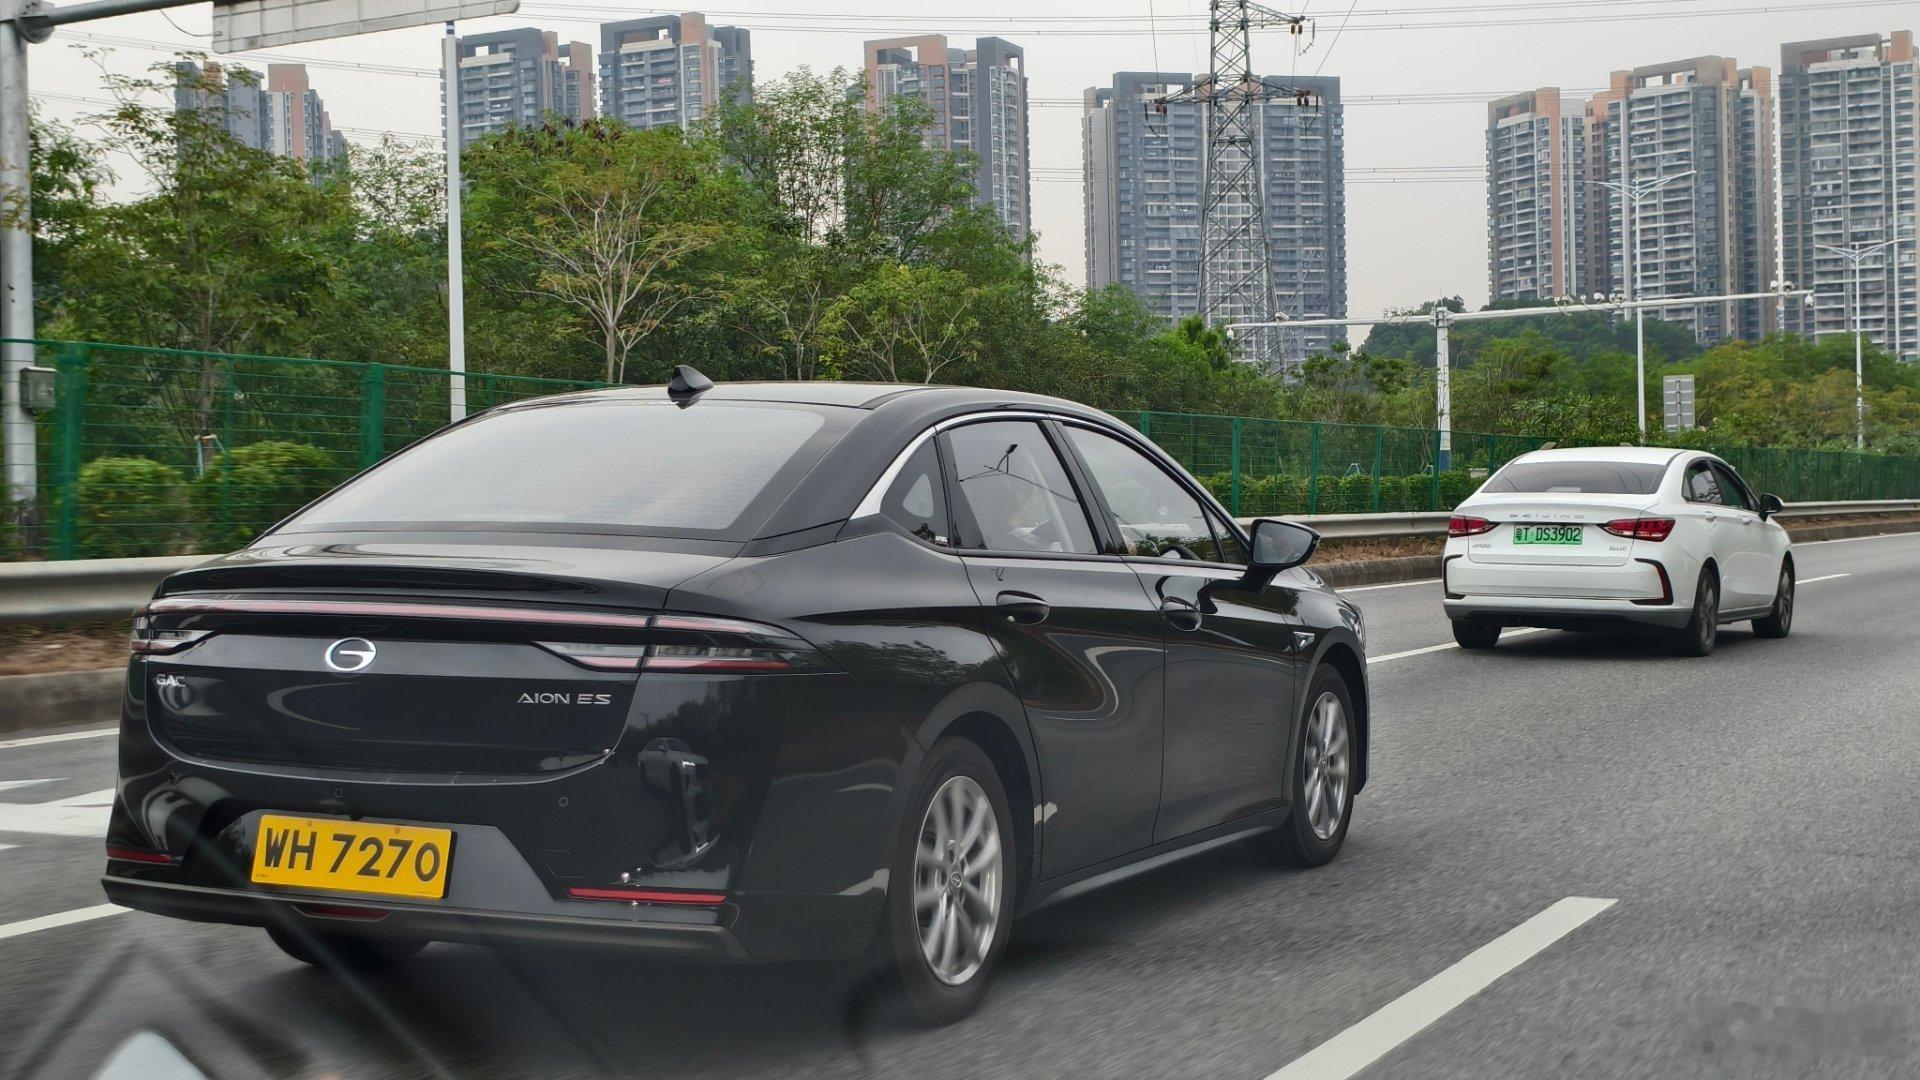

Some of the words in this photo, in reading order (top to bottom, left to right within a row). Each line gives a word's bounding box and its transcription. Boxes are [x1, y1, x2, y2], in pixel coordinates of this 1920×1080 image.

[1536, 527, 1581, 542] DS3902
[156, 673, 187, 688] GAC
[517, 692, 570, 704] AION
[577, 693, 612, 705] ES
[264, 827, 318, 871] WH
[329, 833, 441, 882] 7270
